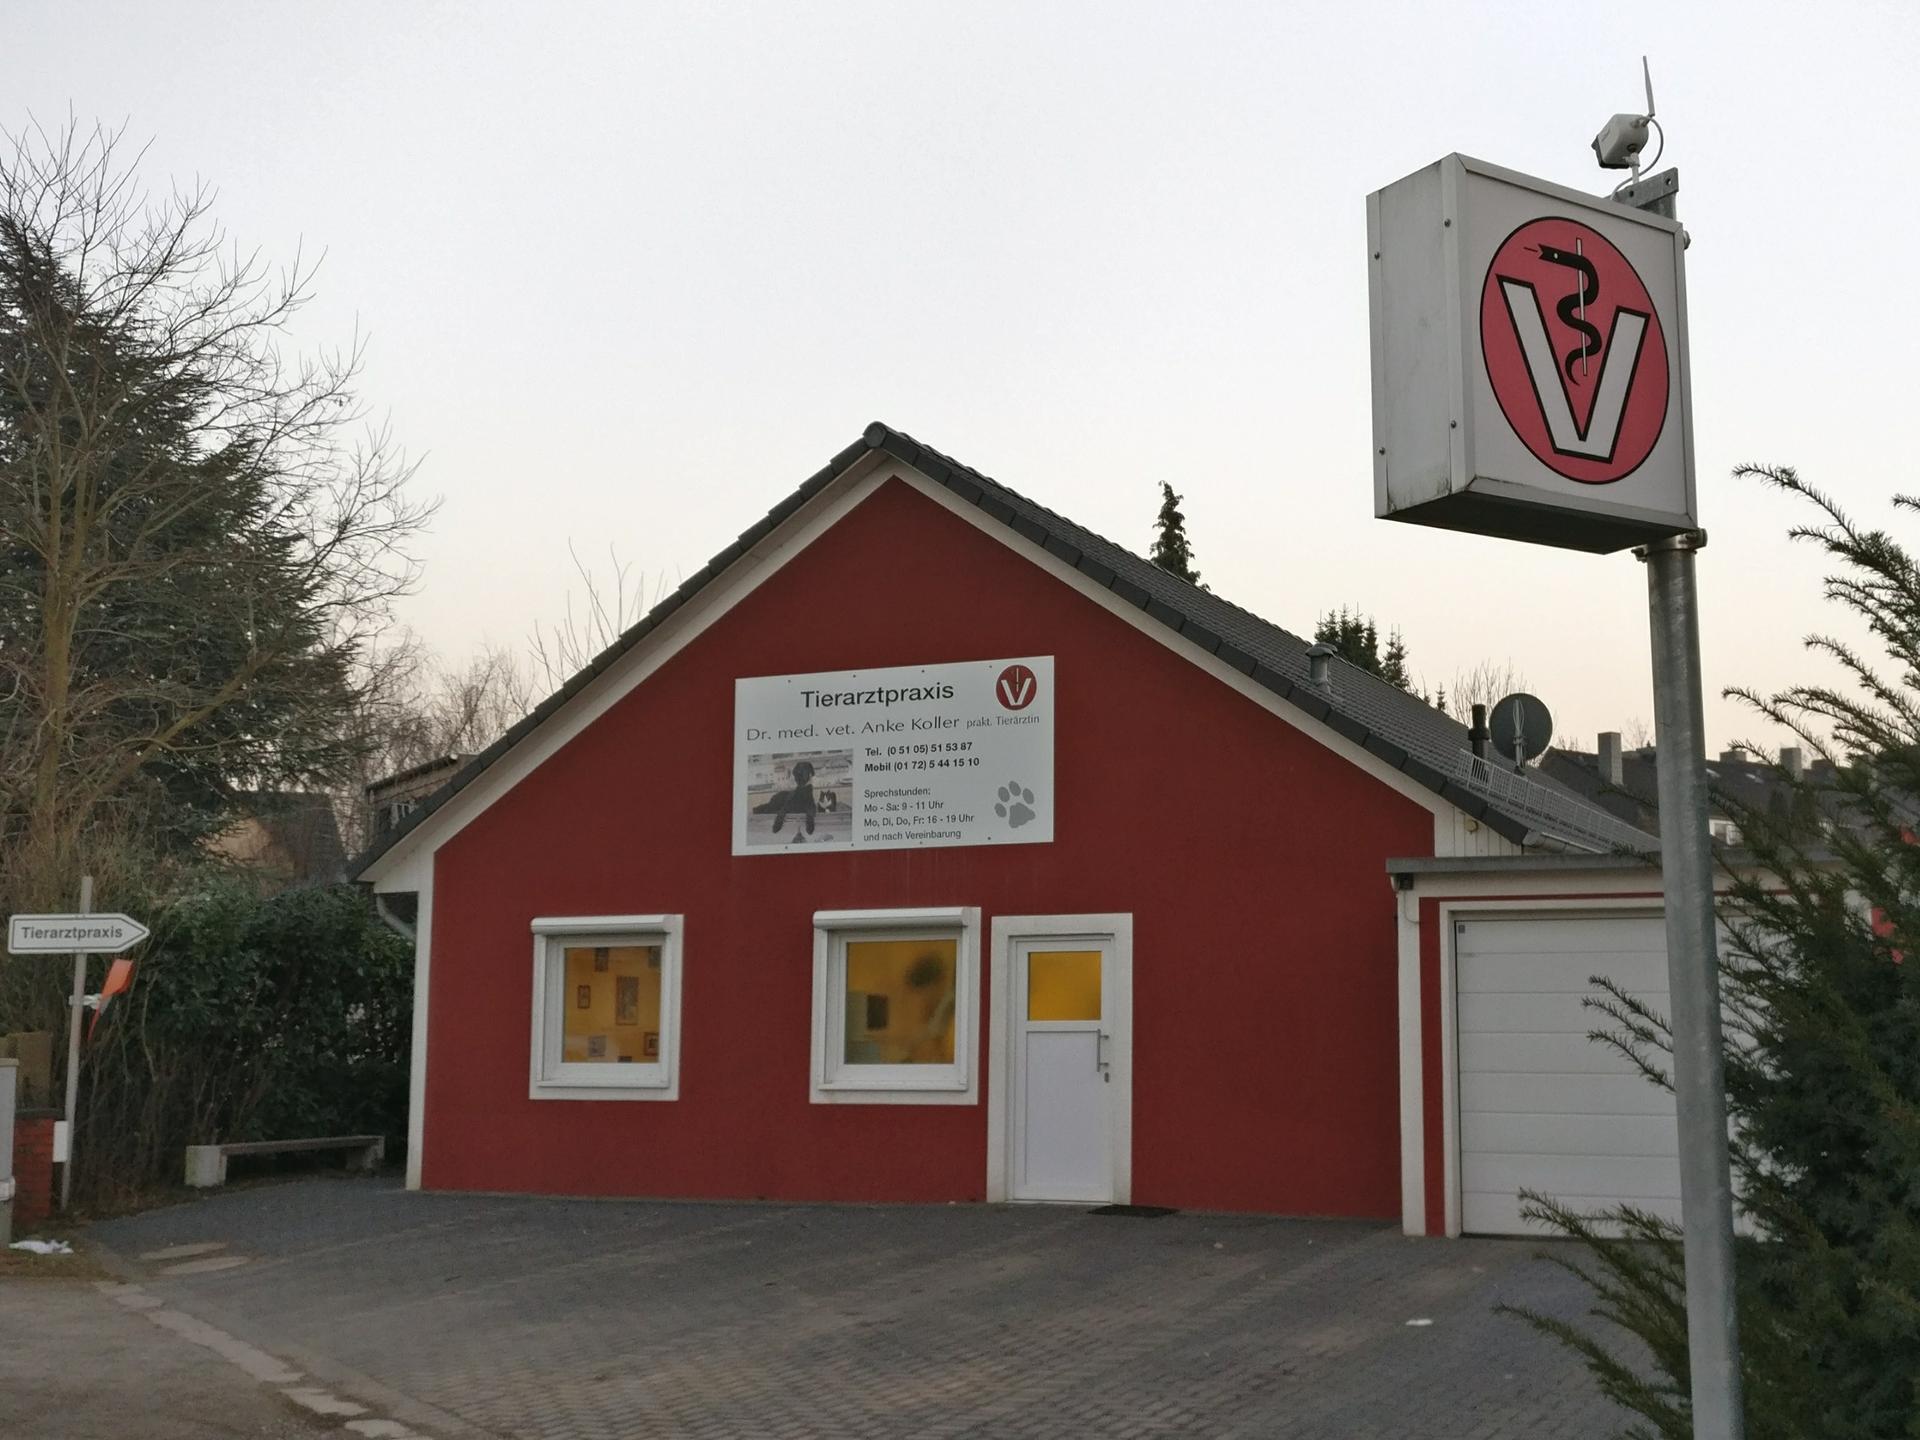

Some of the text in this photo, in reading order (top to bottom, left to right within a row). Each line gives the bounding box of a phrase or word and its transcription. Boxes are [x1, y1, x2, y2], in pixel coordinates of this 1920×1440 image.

[800, 682, 954, 708] Tierarztpraxis
[747, 715, 1040, 741] Dr. med. vet. Anke Koller prakt. Tierärztin
[865, 741, 973, 757] Tel. (0 51 05) 51 53 87
[864, 757, 980, 772] Mobil (01 72) 5 44 15 10
[864, 787, 931, 800] Sprechstunden:
[864, 804, 878, 813] Mo
[885, 802, 900, 812] Sa:
[902, 802, 908, 811] 9
[916, 801, 925, 810] 11
[928, 800, 944, 810] Uhr
[864, 818, 880, 828] Mo,
[882, 817, 894, 827] Di,
[896, 816, 911, 827] Do,
[913, 815, 925, 825] Fr:
[927, 815, 938, 824] 16
[946, 814, 957, 823] 19
[959, 813, 975, 823] Uhr
[864, 830, 961, 841] und nach Vereinbarung
[21, 925, 123, 941] Tierarztpraxis
